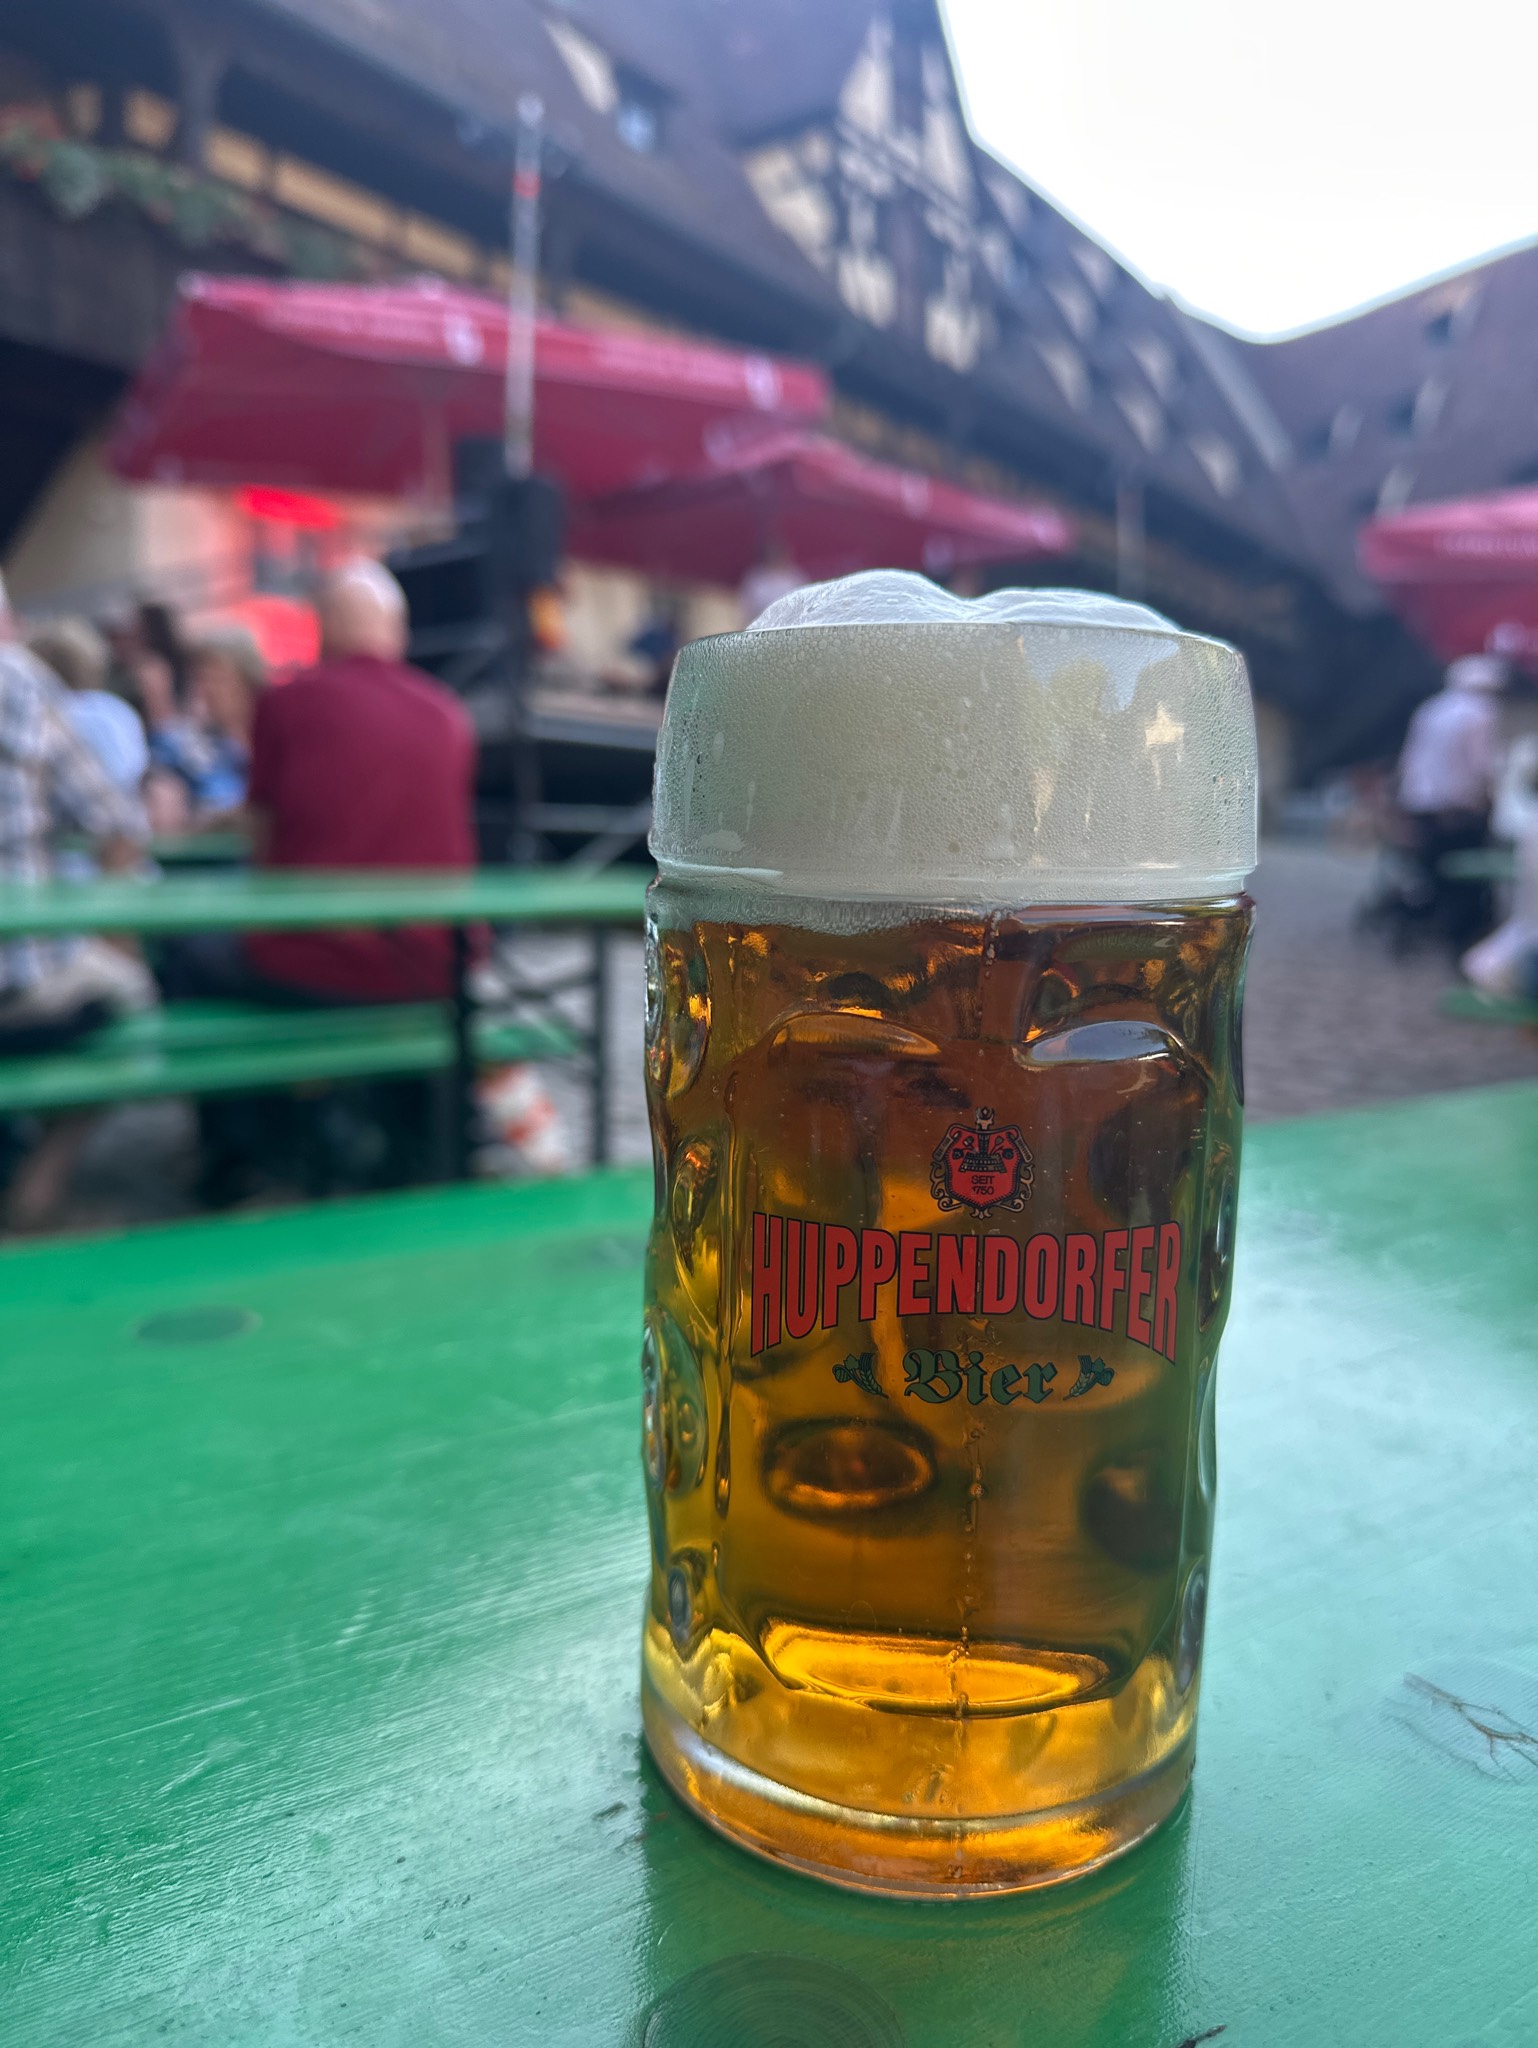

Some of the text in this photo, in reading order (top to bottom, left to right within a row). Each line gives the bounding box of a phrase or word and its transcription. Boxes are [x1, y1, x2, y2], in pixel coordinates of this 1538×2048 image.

[971, 1175, 995, 1184] SEIT
[972, 1186, 995, 1195] 1750
[751, 1212, 1182, 1365] HUPPENDORFER
[902, 1348, 1058, 1405] Bier
